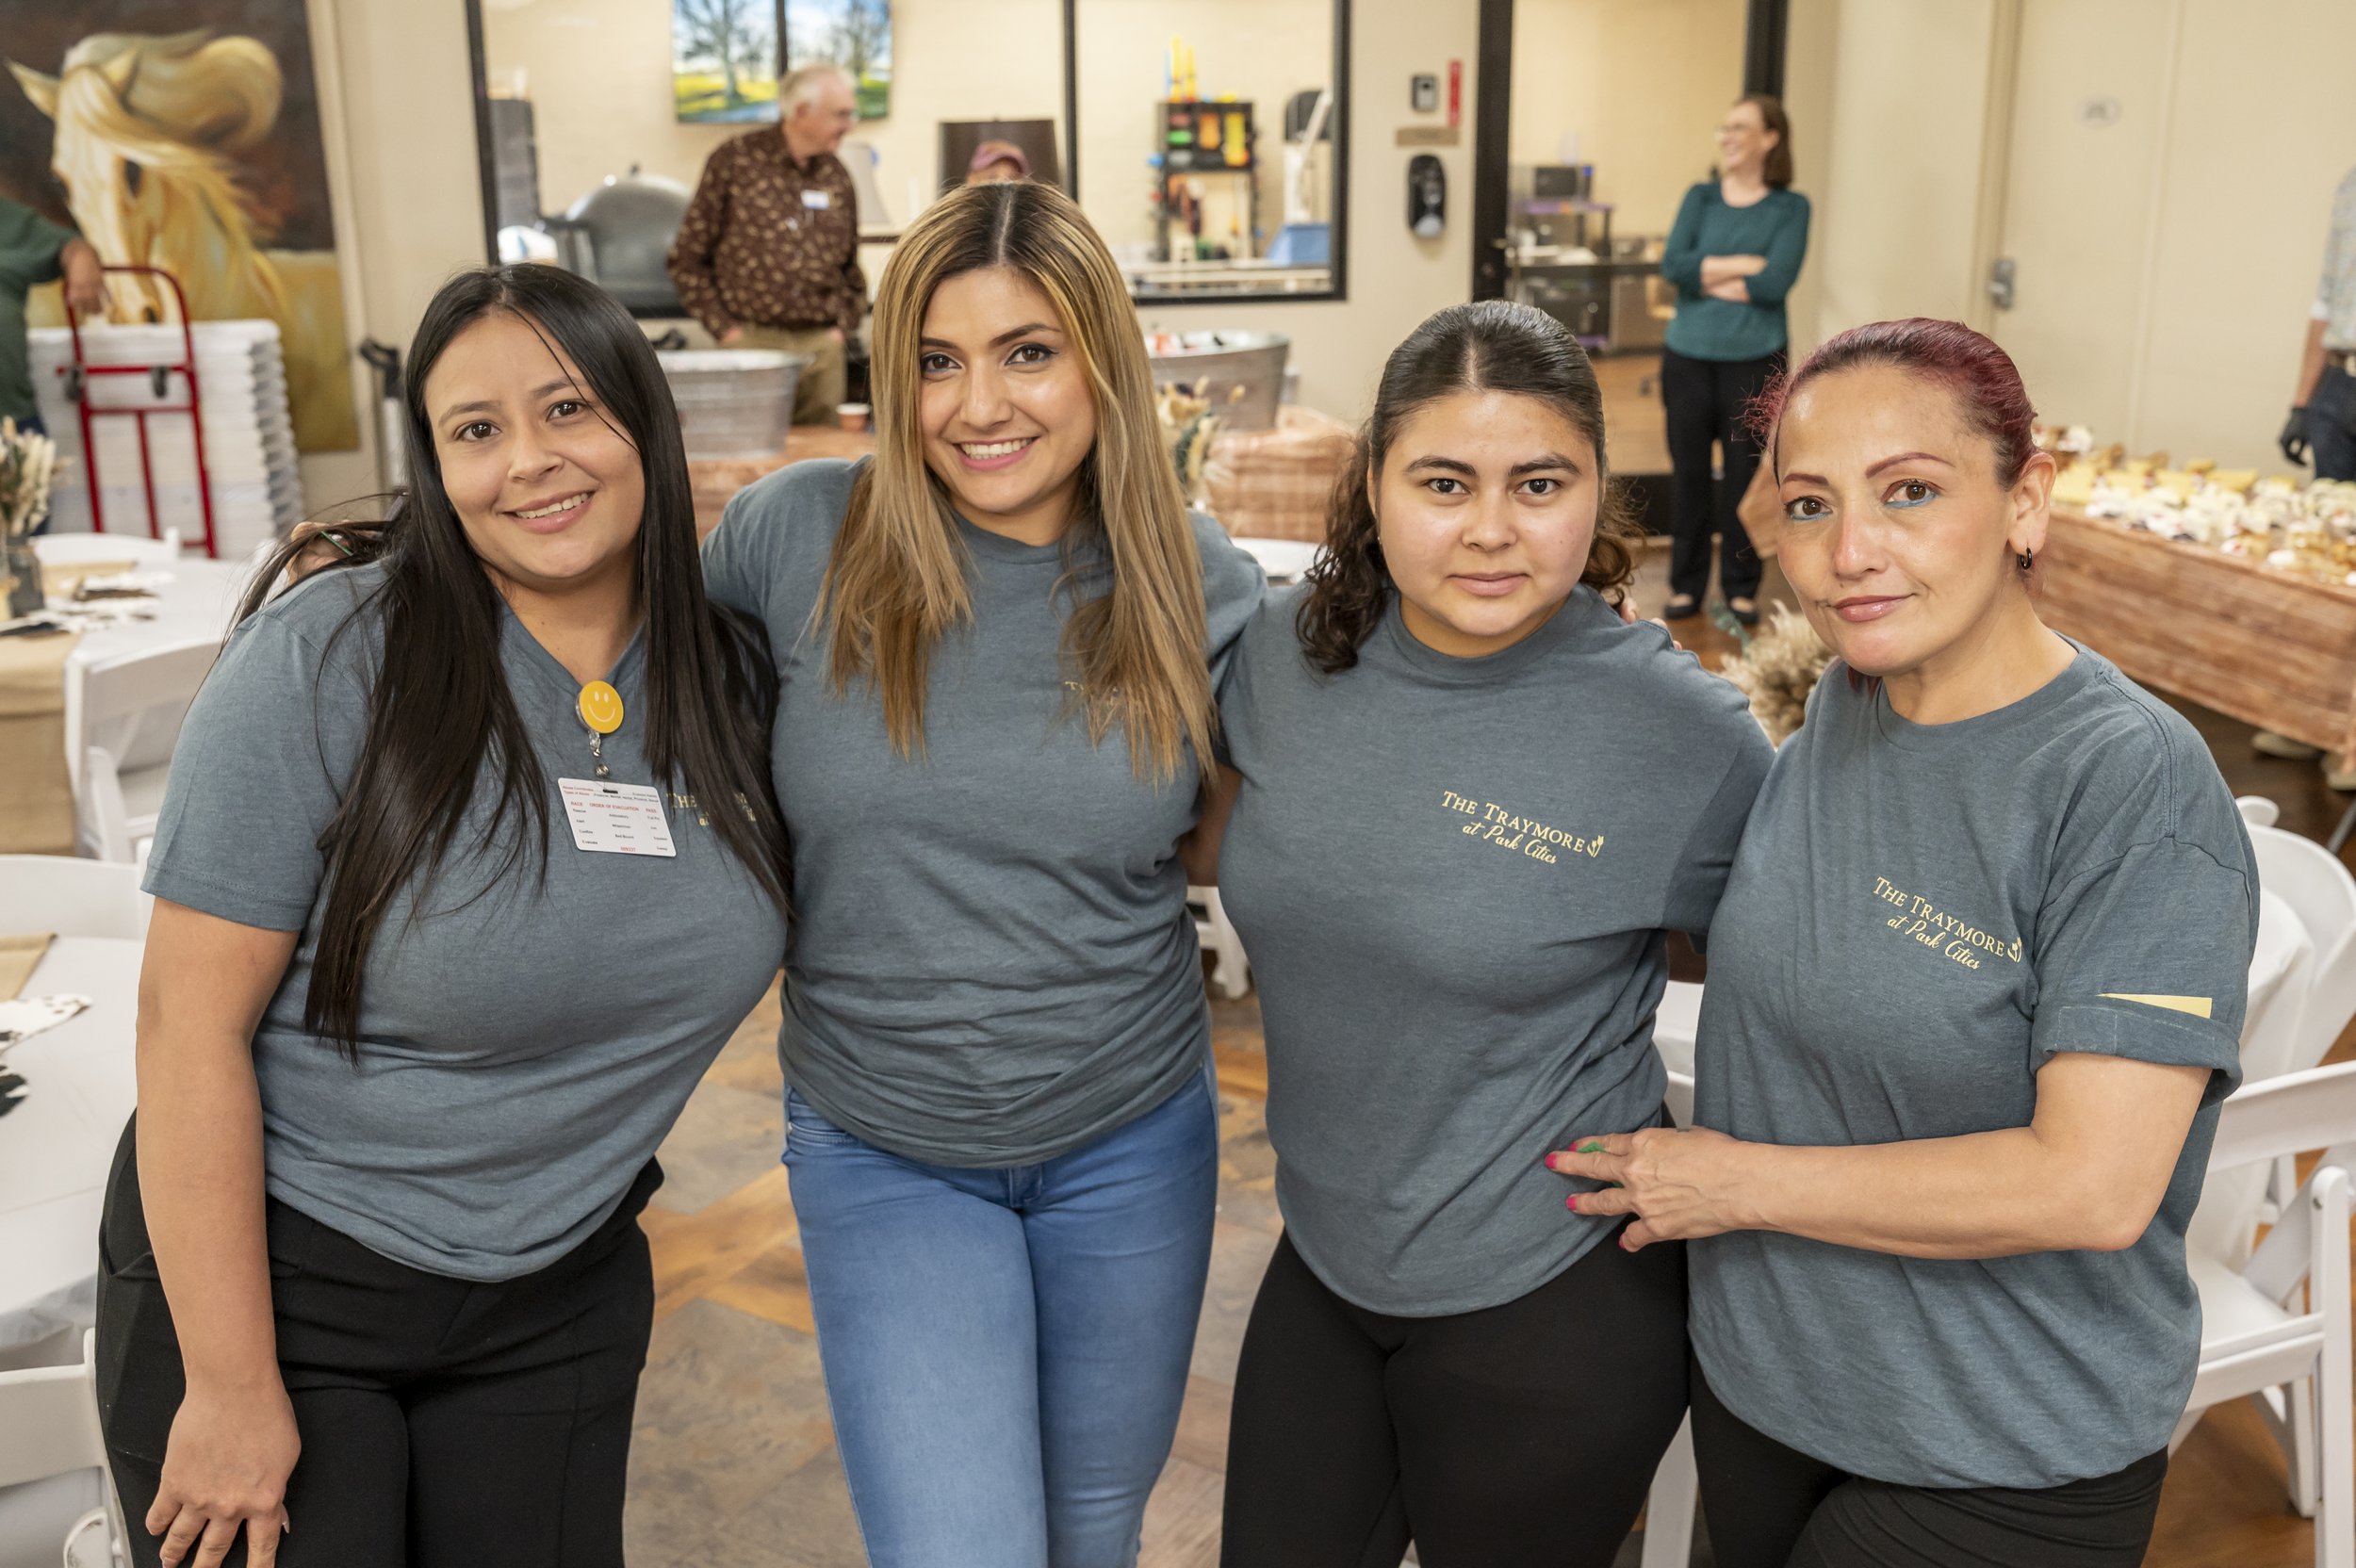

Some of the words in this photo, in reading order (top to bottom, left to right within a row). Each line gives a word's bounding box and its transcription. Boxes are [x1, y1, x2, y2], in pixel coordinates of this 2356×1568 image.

[1442, 791, 1478, 815] THE
[1483, 802, 1585, 853] TRAYMORE
[1463, 822, 1485, 836] at
[1483, 825, 1525, 851] Park
[1524, 839, 1558, 864] Cities
[1873, 876, 1907, 907] THE
[1910, 895, 2004, 957] TRAYMORE
[1887, 915, 1910, 929] at
[1905, 920, 1946, 949] Park
[1945, 940, 1980, 970] Cities
